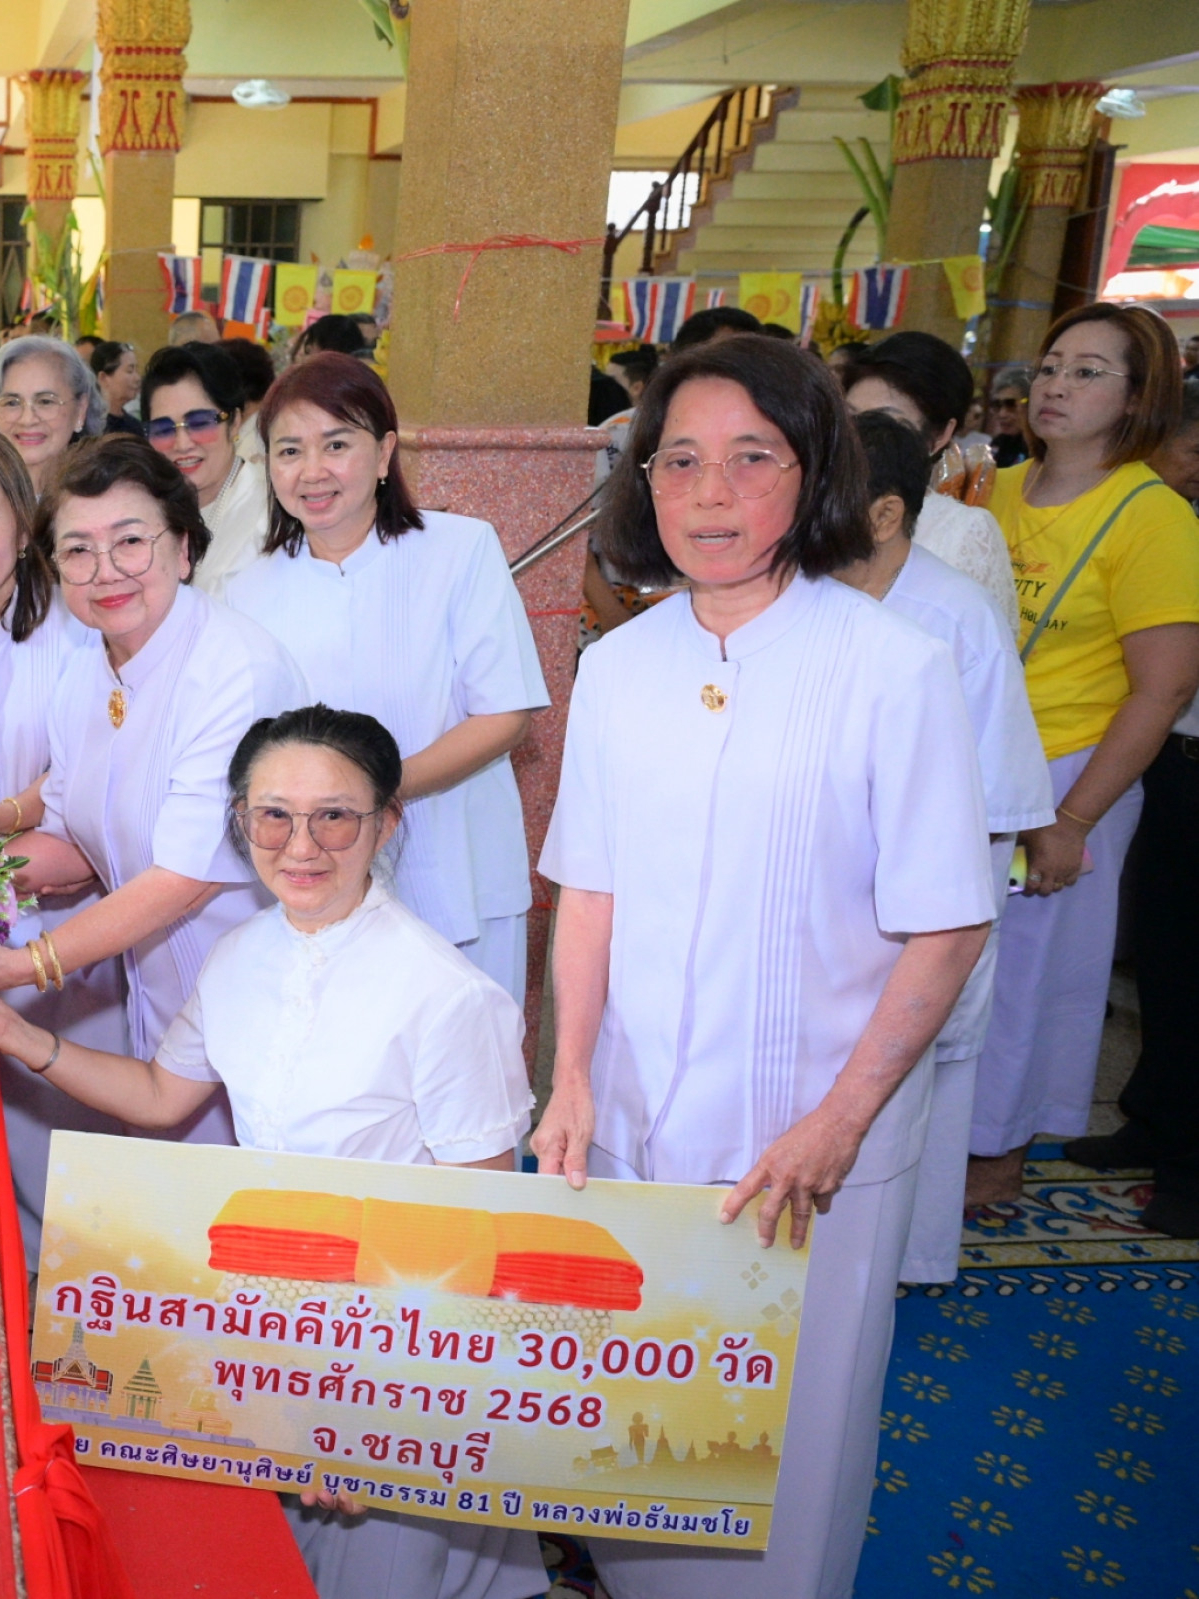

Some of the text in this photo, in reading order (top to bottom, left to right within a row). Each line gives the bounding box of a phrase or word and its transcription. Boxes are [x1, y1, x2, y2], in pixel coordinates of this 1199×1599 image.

[56, 1275, 774, 1384] กฐินสามัคคีทั่วไทย 30,000 วัด
[214, 1360, 603, 1428] พุทธศักราช 2568
[101, 1438, 314, 1483] คณะศิษยานุศิษย์
[323, 1473, 447, 1507] บูชาธรรม
[457, 1492, 490, 1512] 81
[502, 1491, 522, 1516] ปี
[532, 1501, 750, 1536] หลวงพ่อธัมมชโย
[312, 1426, 491, 1485] จ.ชลบุรี
